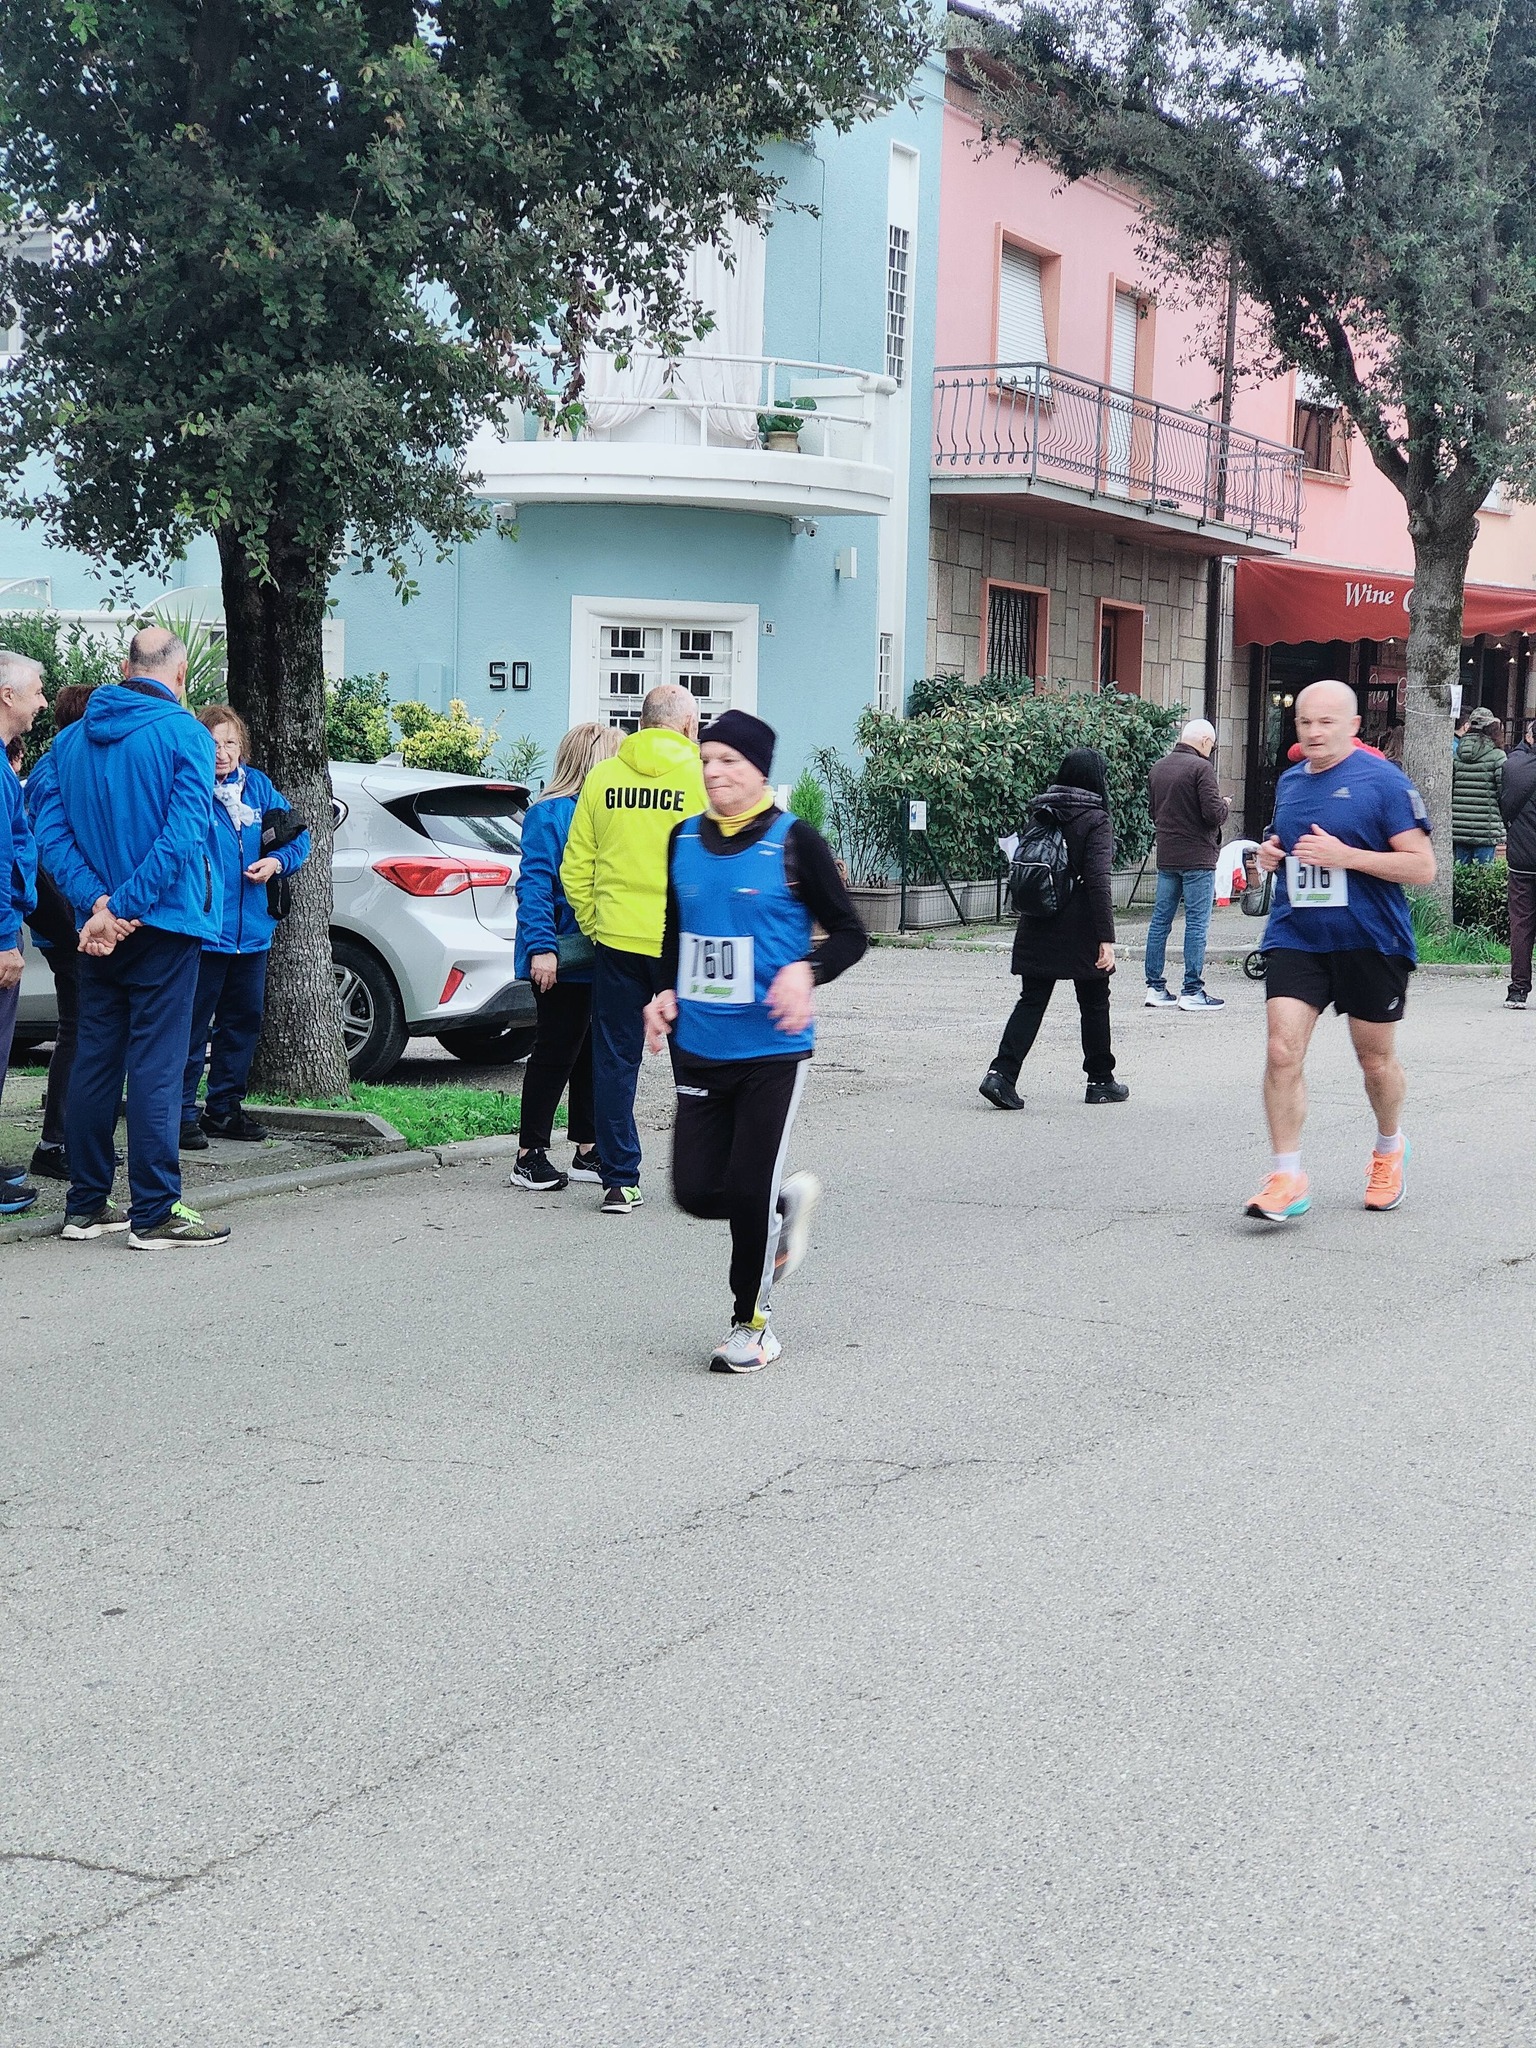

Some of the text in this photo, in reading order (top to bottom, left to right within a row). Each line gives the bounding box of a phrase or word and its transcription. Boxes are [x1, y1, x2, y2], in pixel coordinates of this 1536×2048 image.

[1345, 582, 1395, 607] Wine
[489, 661, 530, 690] 50
[605, 787, 686, 812] GIUDICE
[1298, 861, 1331, 889] 516
